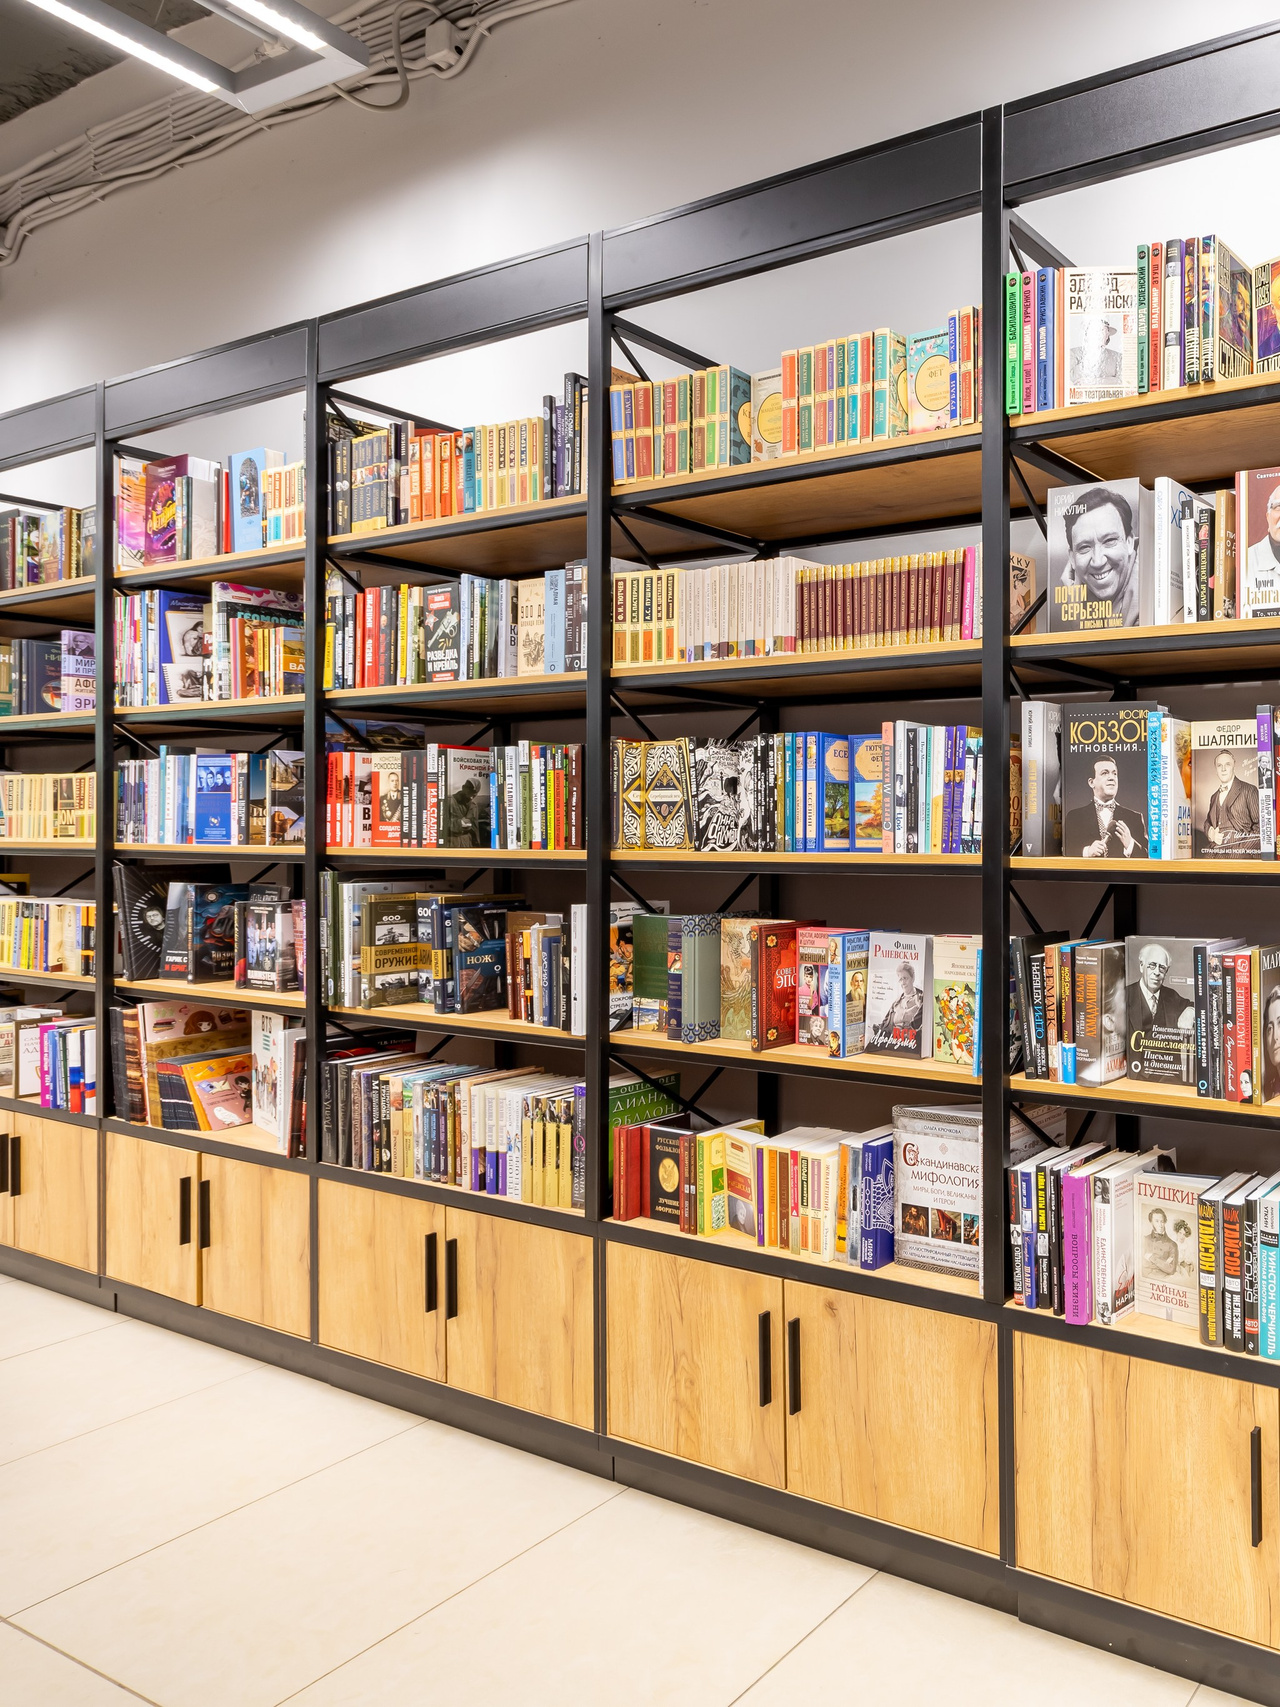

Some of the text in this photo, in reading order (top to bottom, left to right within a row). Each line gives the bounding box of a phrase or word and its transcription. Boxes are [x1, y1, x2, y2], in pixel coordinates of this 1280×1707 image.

[1009, 292, 1017, 341] БАСИЛАШВИЛИ
[1024, 325, 1032, 360] ЛЮДМИЛА
[1009, 343, 1017, 359] ОЛЕГ
[1054, 492, 1074, 505] ЮРИЙ
[1054, 504, 1087, 516] НИКУЛИН
[1255, 577, 1274, 590] Армен
[1054, 584, 1087, 604] ПОЧТИ
[1061, 601, 1123, 621] СЕРЬЕЗНО...
[1085, 621, 1103, 629] ПИСЬМА
[427, 650, 458, 661] РАЗВЕДКА
[433, 659, 458, 671] КРЕМЛЬ
[874, 944, 919, 961] РАНЕВСКАЯ
[894, 940, 916, 950] Фаина
[375, 955, 417, 968] ОРУЖИЕ
[1045, 965, 1055, 1028] РЕМАРК
[1236, 987, 1245, 1048] НАСТОЯЩЕЕ
[1143, 1051, 1173, 1061] Письма
[1150, 1060, 1186, 1071] дневники
[911, 1170, 979, 1189] МИФОЛОГИЯ
[1138, 1182, 1199, 1205] ПУШКИН
[1199, 1218, 1215, 1272] ТАЙСОН
[1224, 1221, 1241, 1276] ТАЙСОН
[1150, 1283, 1187, 1299] ТАЙНАЯ
[1150, 1294, 1189, 1308] ЛЮБОВЬ
[1267, 1250, 1276, 1356] УИНСТОН ЧЕРЧИЛЛЬ
[1233, 1294, 1241, 1339] ЖЕЛЕЗНЫЕ
